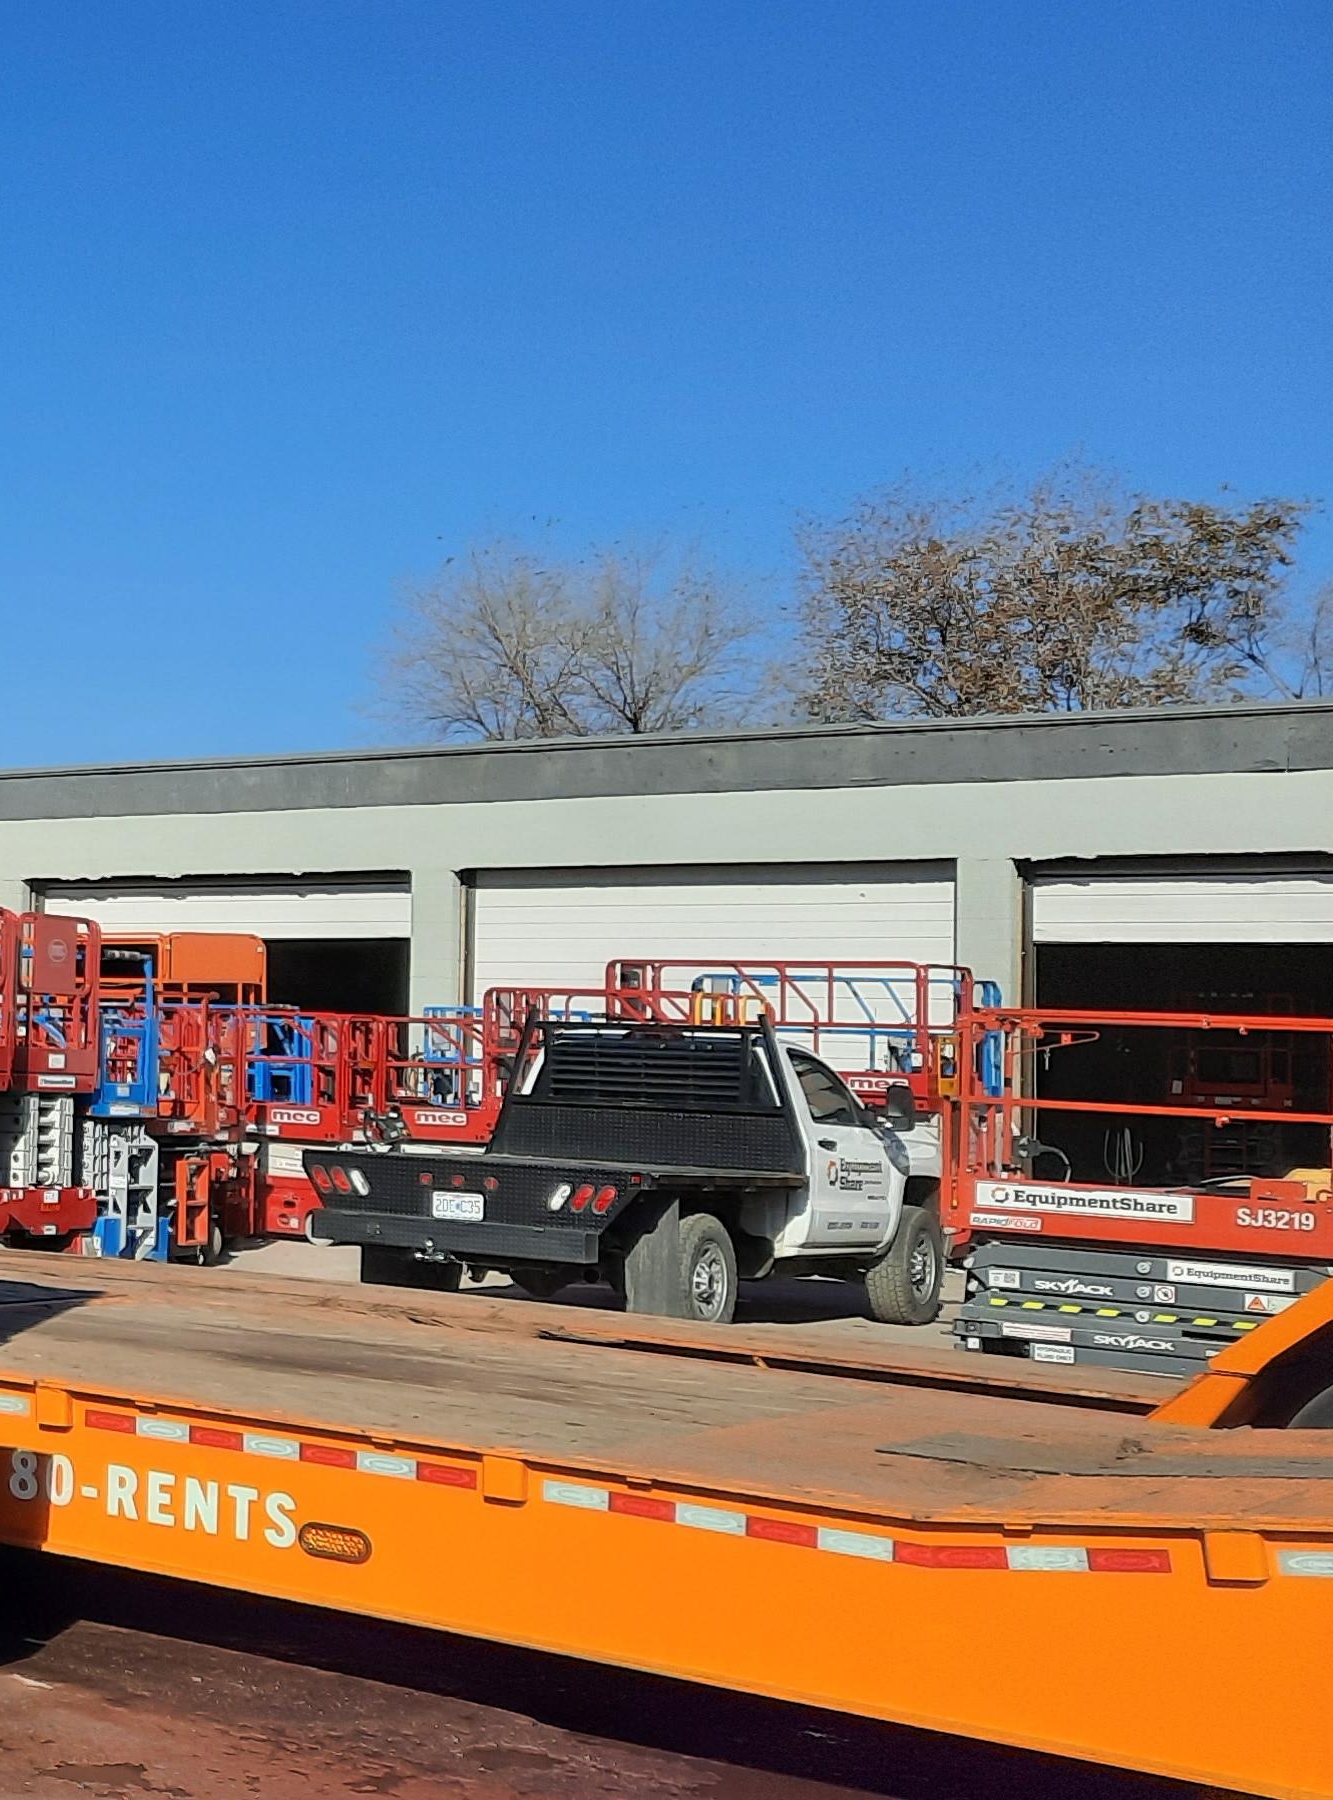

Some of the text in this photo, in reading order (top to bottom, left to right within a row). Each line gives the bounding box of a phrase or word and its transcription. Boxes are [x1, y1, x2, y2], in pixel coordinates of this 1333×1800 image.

[416, 1113, 465, 1123] mec
[1013, 1189, 1178, 1214] EquipmentShare
[1236, 1207, 1315, 1231] SJ3219
[1186, 1267, 1290, 1285] EquipmentShare
[1034, 1279, 1114, 1296] SKYJACK
[1093, 1335, 1175, 1351] SKYJACK
